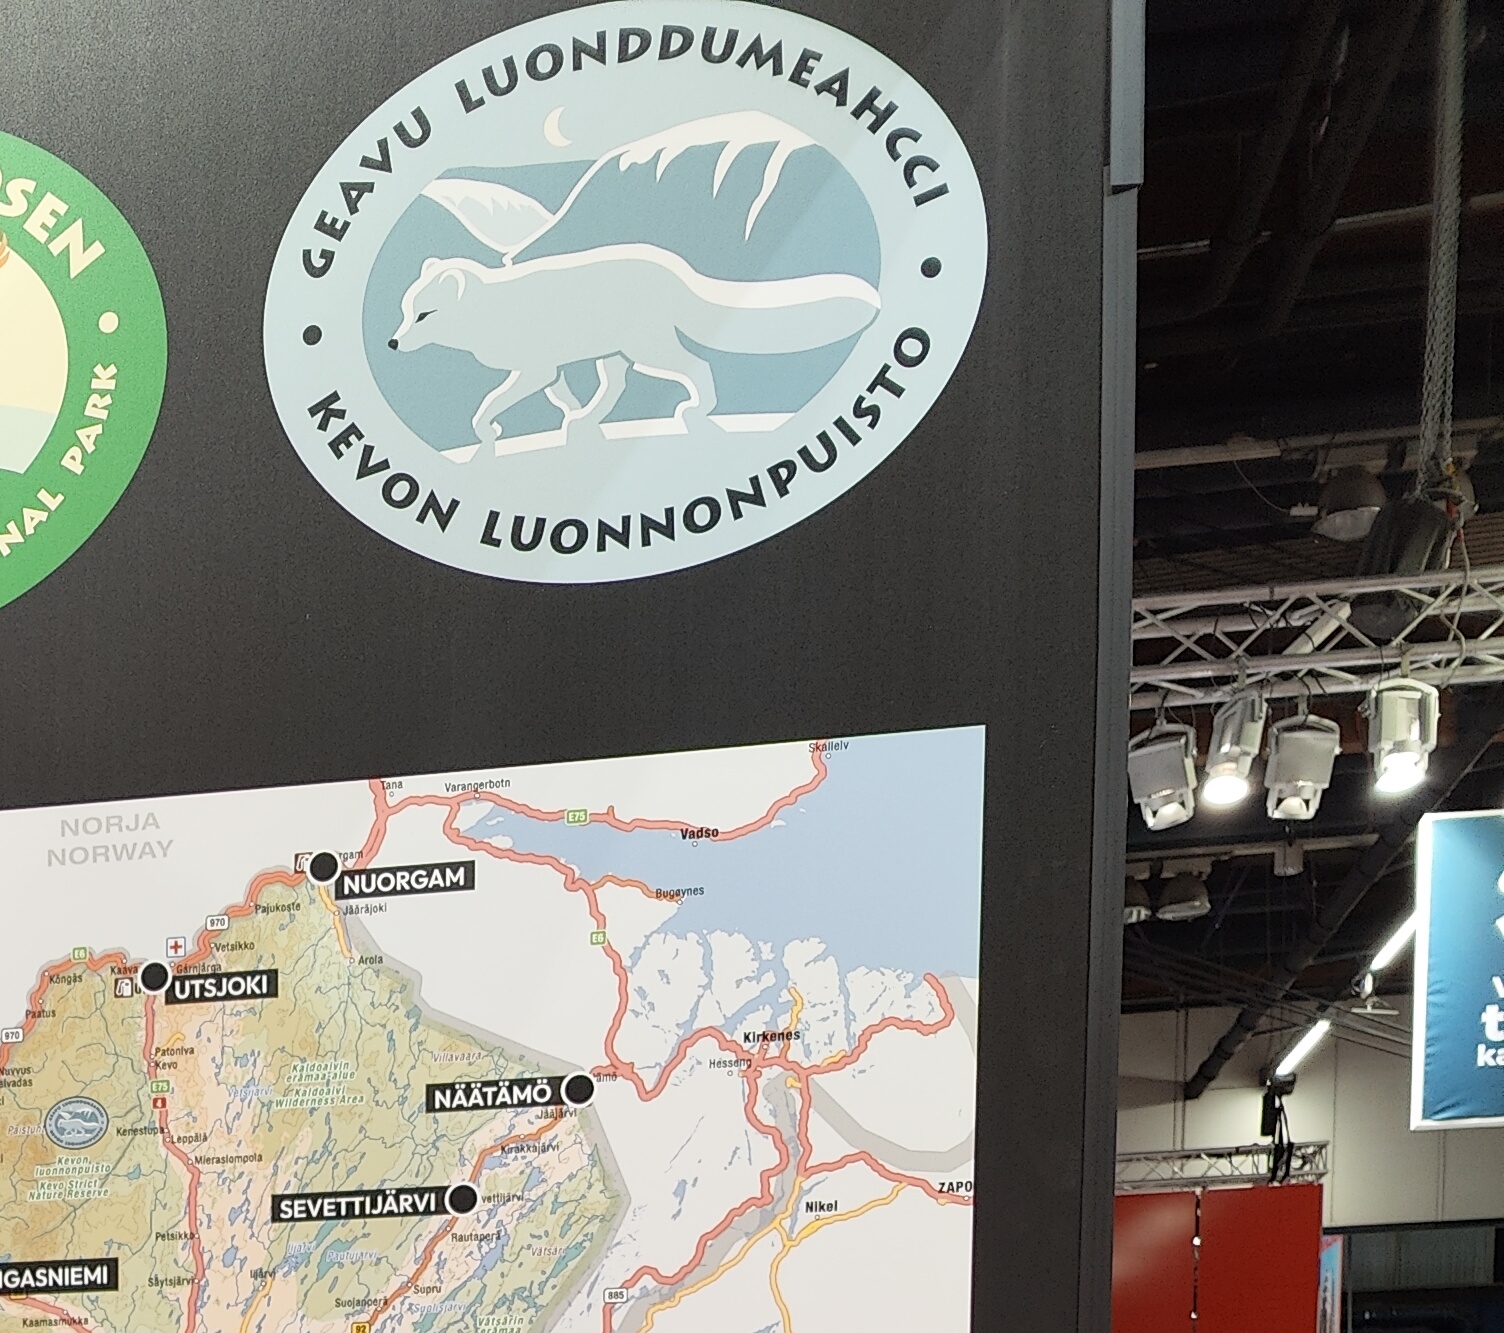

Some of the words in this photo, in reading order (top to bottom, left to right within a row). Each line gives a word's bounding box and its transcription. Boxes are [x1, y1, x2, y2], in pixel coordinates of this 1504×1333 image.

[302, 107, 432, 279] GEAVU
[454, 25, 950, 207] LUONDDUMEAHCCI
[61, 363, 117, 475] PARK
[307, 390, 460, 532] KEVON
[480, 327, 931, 555] LUONNONPUISTO
[382, 779, 403, 790] Tana
[445, 778, 511, 793] Varangerbotn
[568, 811, 585, 822] E75
[60, 812, 160, 837] NORJA
[47, 839, 174, 867] NORWAY
[344, 868, 465, 894] NUORGAM
[255, 902, 301, 914] Pajukoste
[210, 918, 225, 928] 970
[215, 940, 255, 952] Vetsikko
[358, 954, 383, 966] Arola
[175, 976, 267, 999] UTSJOKI
[744, 1029, 800, 1044] Kirkenes
[154, 1046, 194, 1057] Patoniva
[155, 1060, 178, 1070] Kevo
[434, 1080, 551, 1109] NÄÄTÄMÖ
[171, 1132, 208, 1145] Leppälä
[194, 1153, 263, 1166] Mieraslompola
[938, 1180, 973, 1194] ZAPO
[279, 1190, 435, 1219] SEVETTIJÄRVI
[805, 1201, 838, 1214] Nikel
[155, 1231, 194, 1242] Petsikko
[451, 1231, 501, 1243] Rautaperä
[414, 1283, 442, 1296] Supru
[607, 1290, 624, 1300] 885
[22, 1316, 88, 1328] Kaamasmukka
